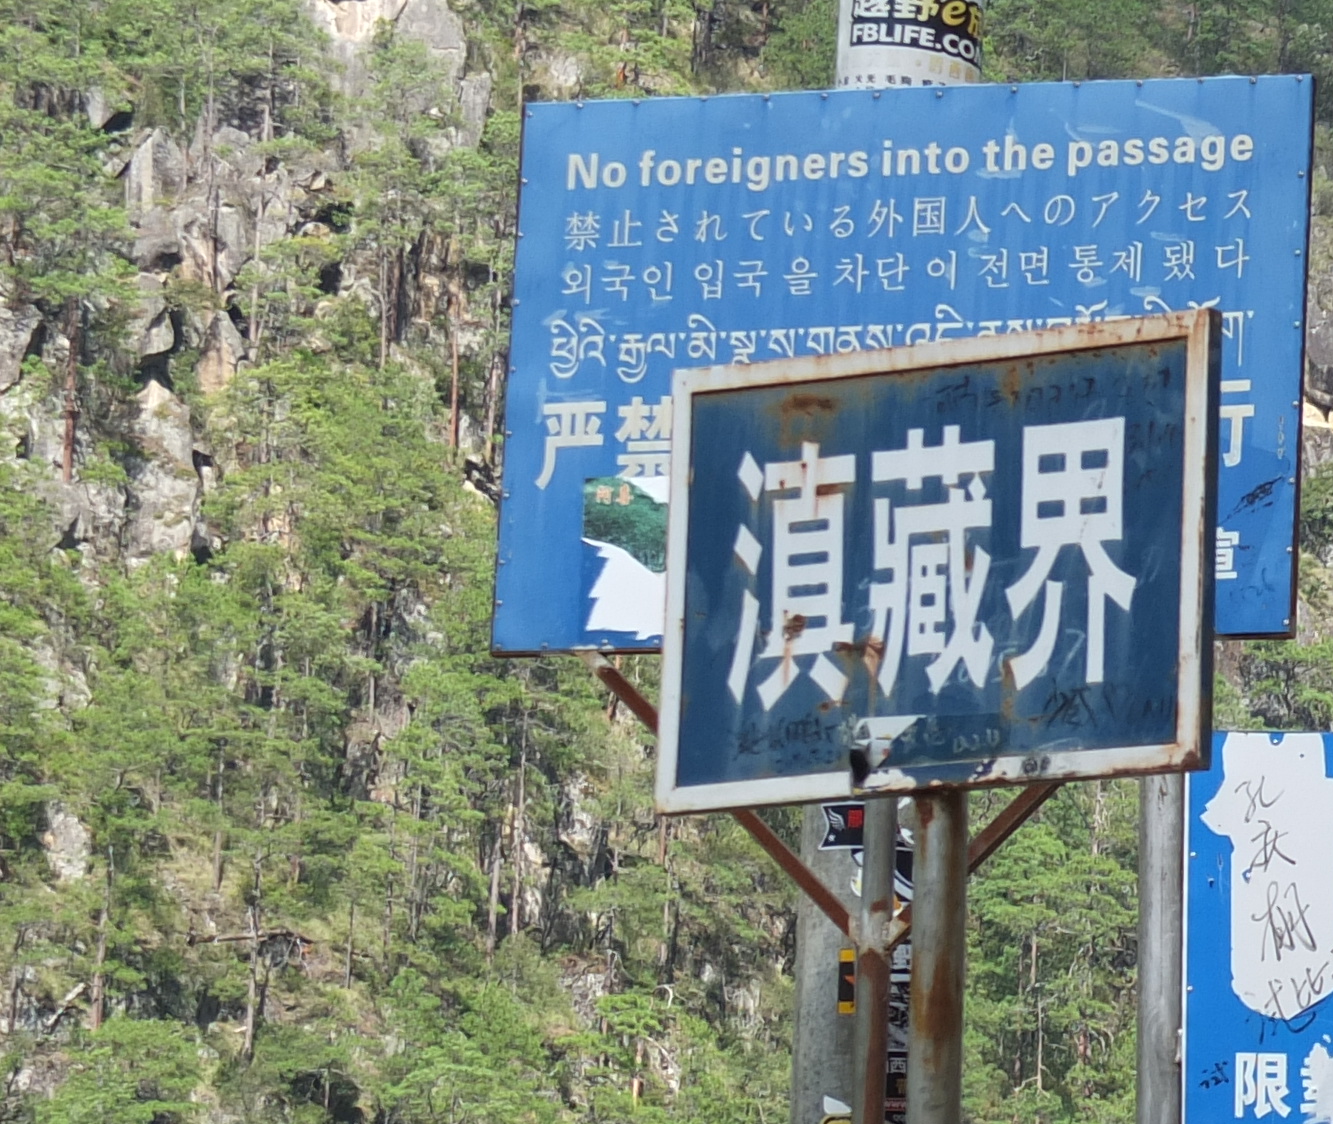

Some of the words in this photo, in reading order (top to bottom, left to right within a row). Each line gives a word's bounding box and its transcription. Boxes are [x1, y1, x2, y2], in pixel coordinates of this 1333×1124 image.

[853, 23, 980, 66] FBLIFE.CO
[567, 152, 626, 190] No
[639, 147, 868, 192] foreigners
[882, 139, 969, 177] into
[983, 135, 1055, 172] the
[1067, 133, 1254, 177] passage
[564, 189, 1251, 251] 禁止されている外国人へのアクセス
[561, 261, 673, 304] 외국인
[694, 259, 769, 300] 입국
[783, 257, 819, 295] 을
[833, 252, 910, 294] 차단
[927, 250, 957, 289] 이
[977, 244, 1050, 288] 전면
[1068, 240, 1145, 283] 통제
[1215, 238, 1250, 279] 다
[728, 417, 1136, 711] 滇藏界
